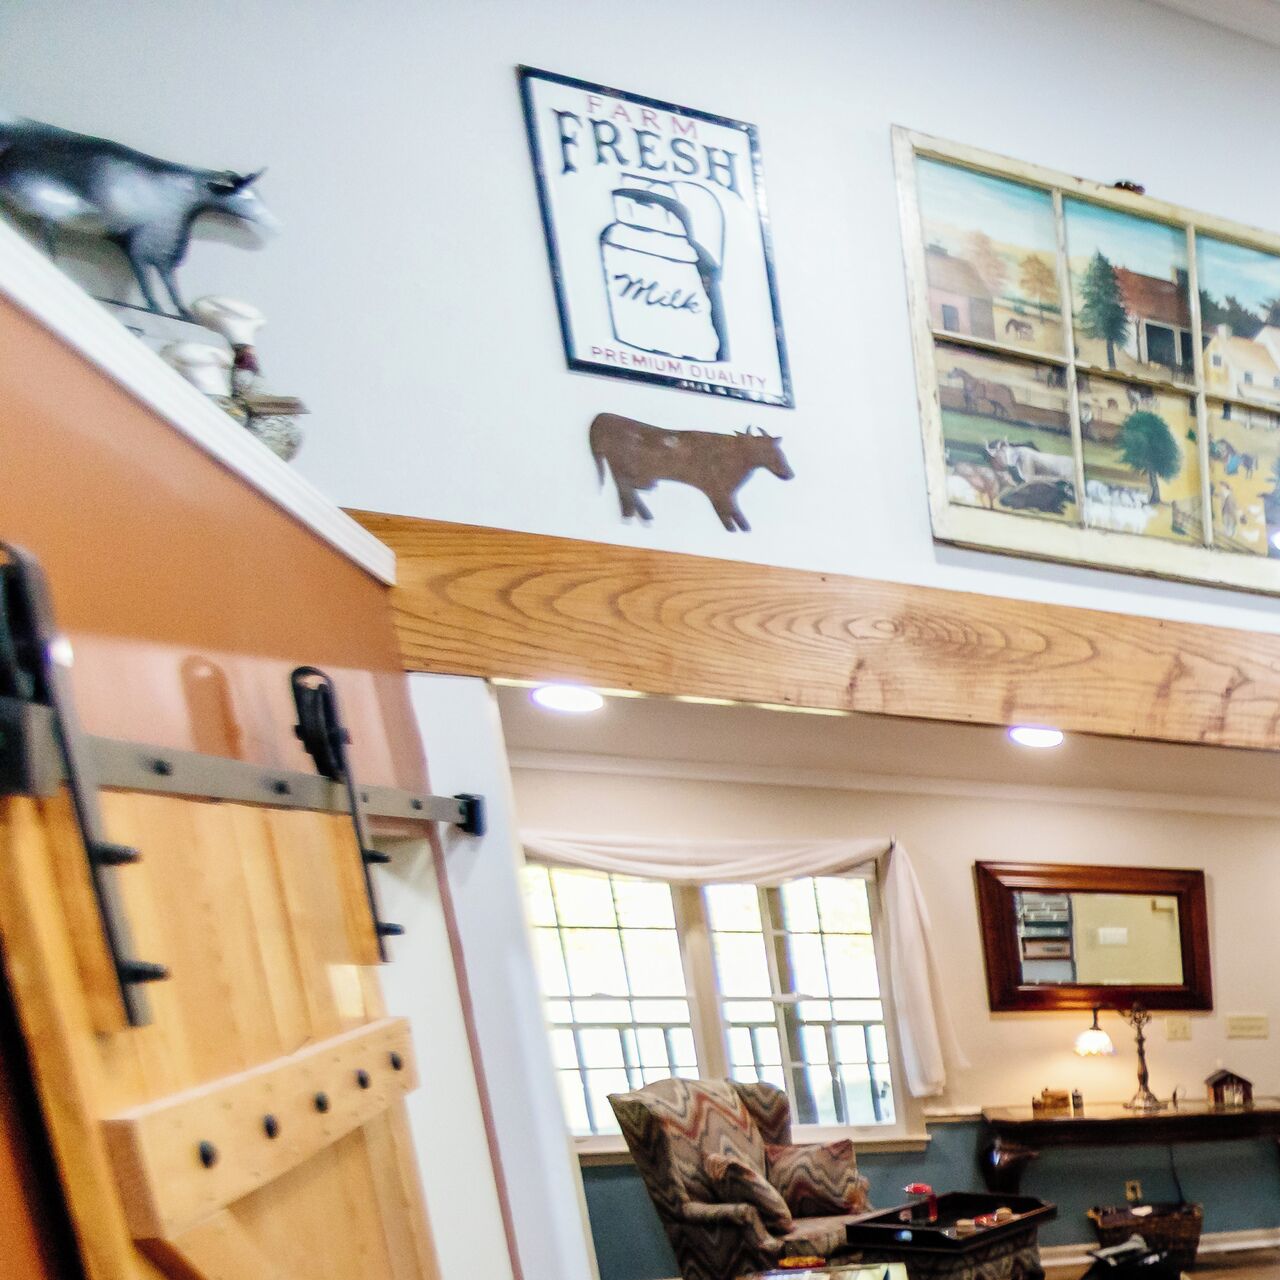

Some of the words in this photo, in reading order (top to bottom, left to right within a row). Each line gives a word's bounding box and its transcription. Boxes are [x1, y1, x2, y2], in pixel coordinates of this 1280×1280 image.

[587, 94, 698, 140] FARM
[552, 108, 745, 201] FRESH
[614, 273, 701, 314] Milk
[591, 346, 684, 374] PREMIUM
[690, 364, 768, 388] QUALITY
